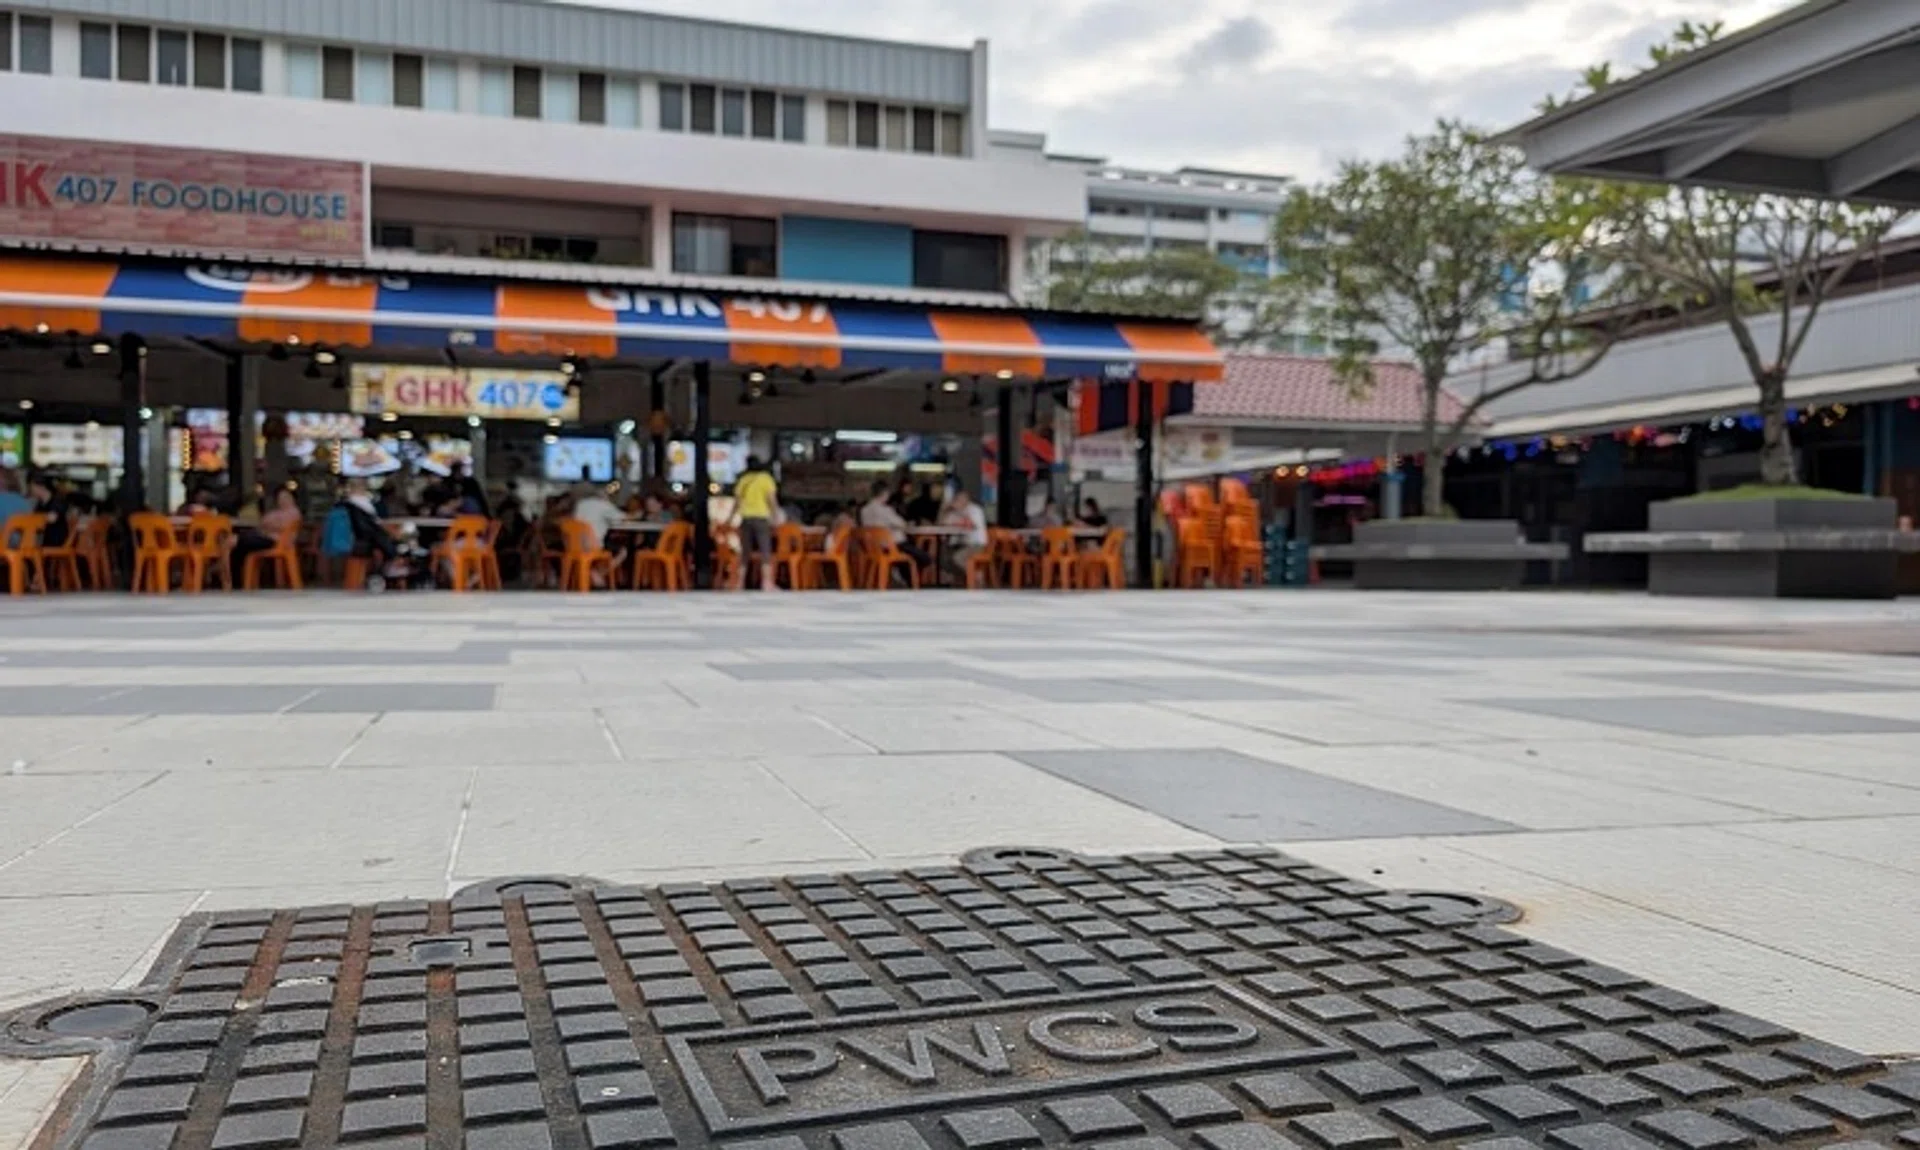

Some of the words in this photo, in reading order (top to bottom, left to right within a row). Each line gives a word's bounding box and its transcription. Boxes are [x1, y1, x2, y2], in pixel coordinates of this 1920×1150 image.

[56, 175, 117, 203] 407
[132, 180, 346, 220] FOODHOUSE
[394, 377, 471, 409] GHK
[479, 381, 538, 408] 407
[733, 1001, 1260, 1106] PWCS
